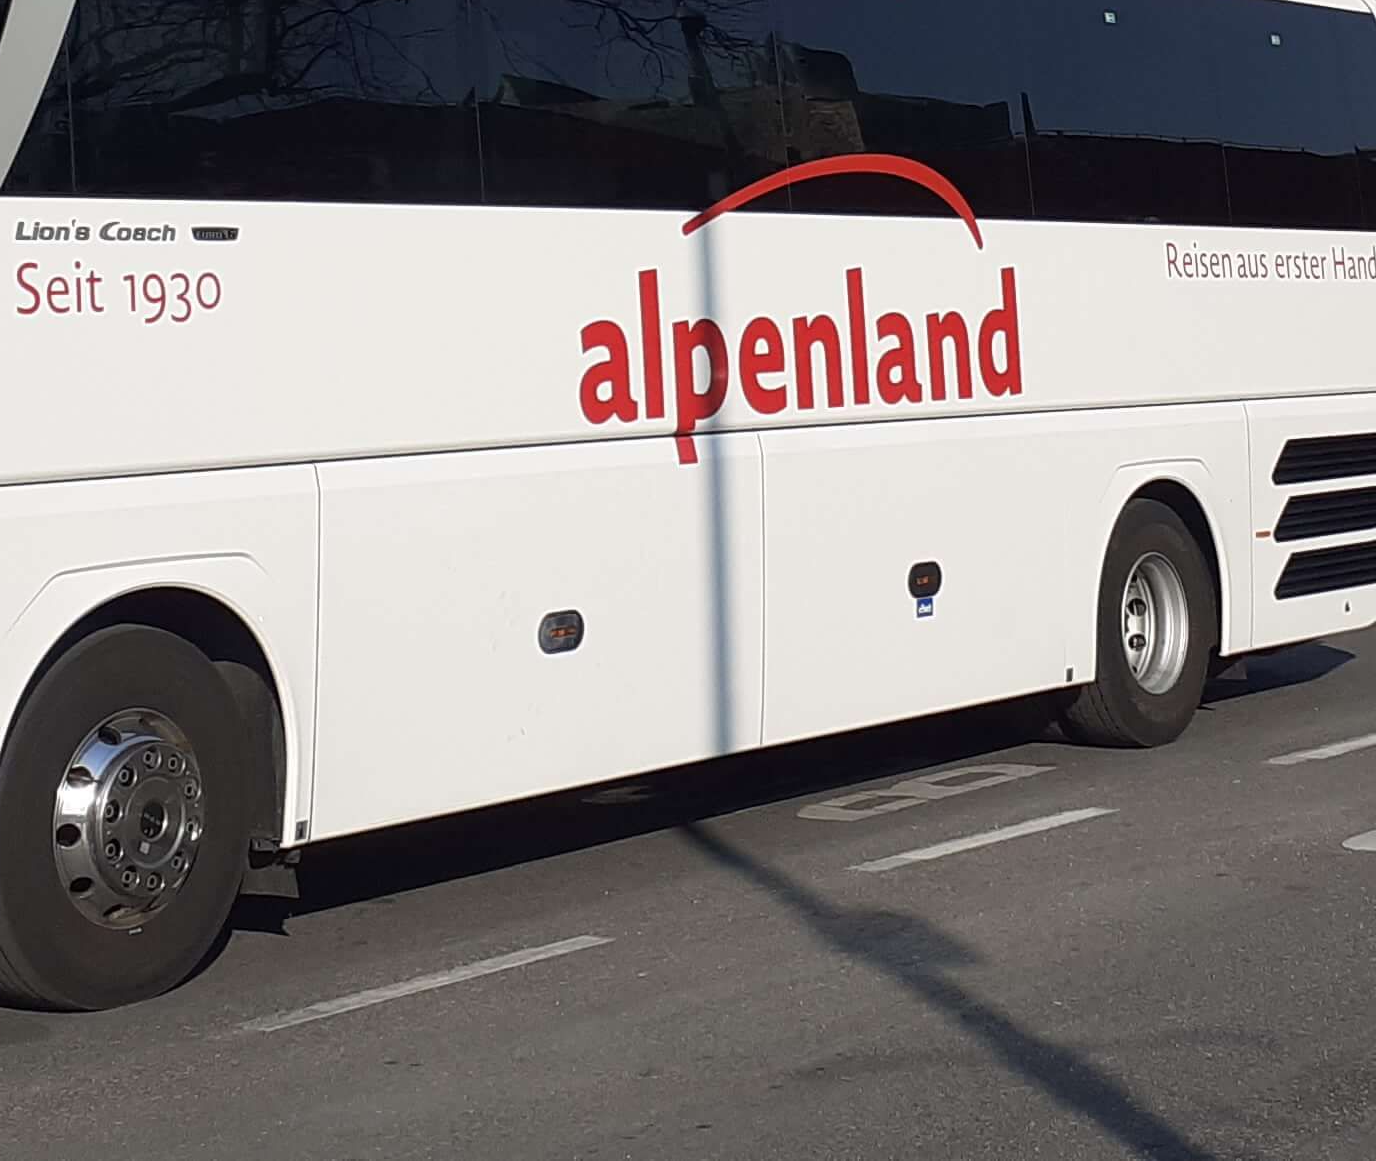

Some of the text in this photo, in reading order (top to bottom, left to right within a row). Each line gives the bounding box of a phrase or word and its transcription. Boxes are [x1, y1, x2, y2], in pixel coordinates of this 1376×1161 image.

[15, 219, 90, 241] Lion's
[99, 221, 176, 241] Coach
[1166, 242, 1233, 279] Reisen
[1237, 253, 1269, 279] aus
[1275, 252, 1326, 280] erster
[16, 261, 221, 324] Seit 1930
[579, 267, 1023, 465] alpenland
